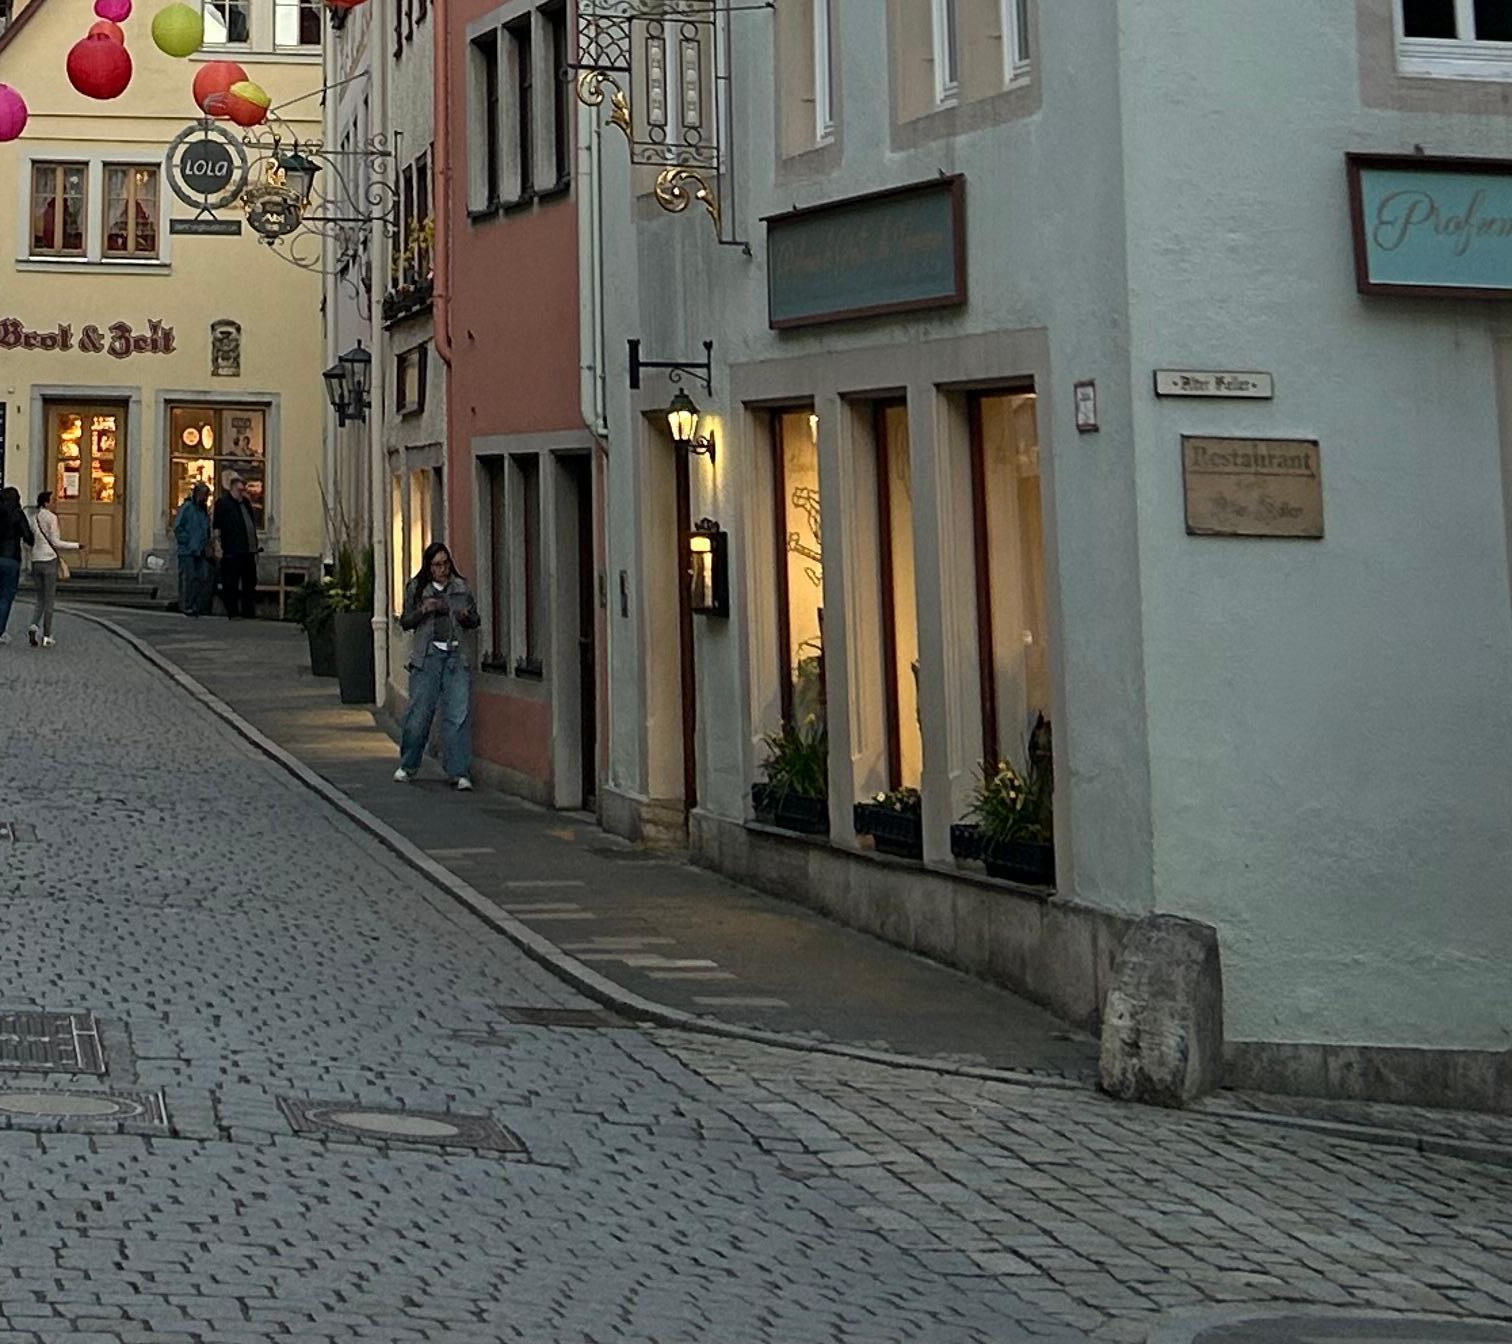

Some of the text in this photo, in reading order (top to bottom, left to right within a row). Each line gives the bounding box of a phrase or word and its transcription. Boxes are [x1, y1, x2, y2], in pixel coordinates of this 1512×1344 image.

[78, 324, 105, 353] &
[107, 318, 177, 360] Zeit
[1192, 445, 1313, 470] Restaurant
